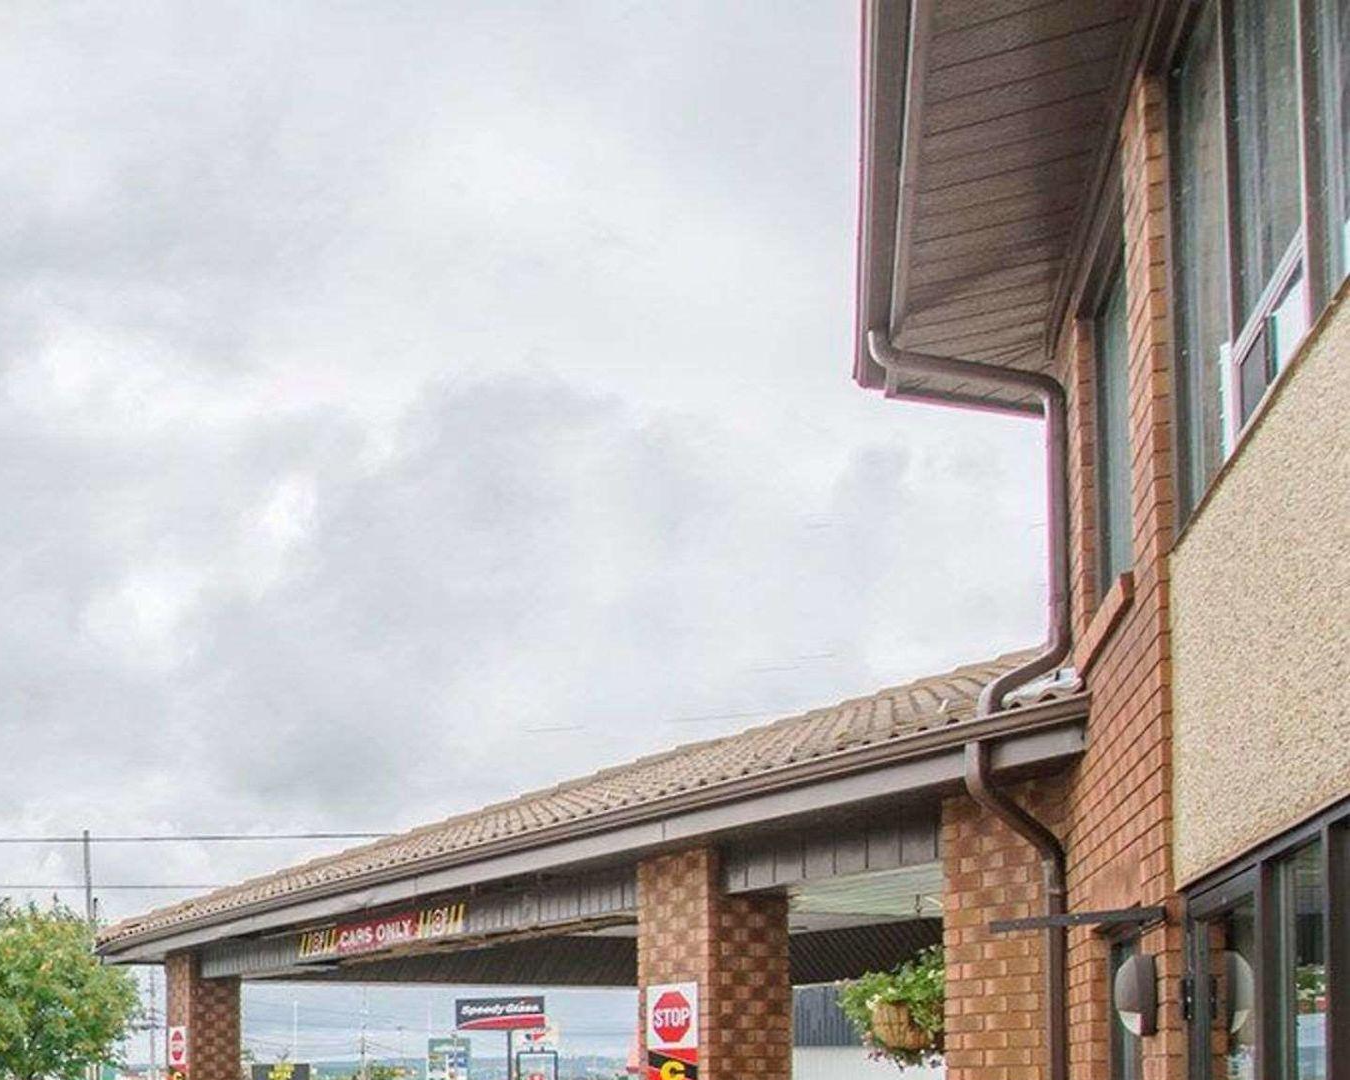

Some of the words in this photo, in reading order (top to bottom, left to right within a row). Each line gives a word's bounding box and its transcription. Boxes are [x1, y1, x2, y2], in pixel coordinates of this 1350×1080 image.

[339, 926, 374, 947] CARS
[376, 919, 413, 942] ONLY
[653, 1006, 690, 1029] STOP
